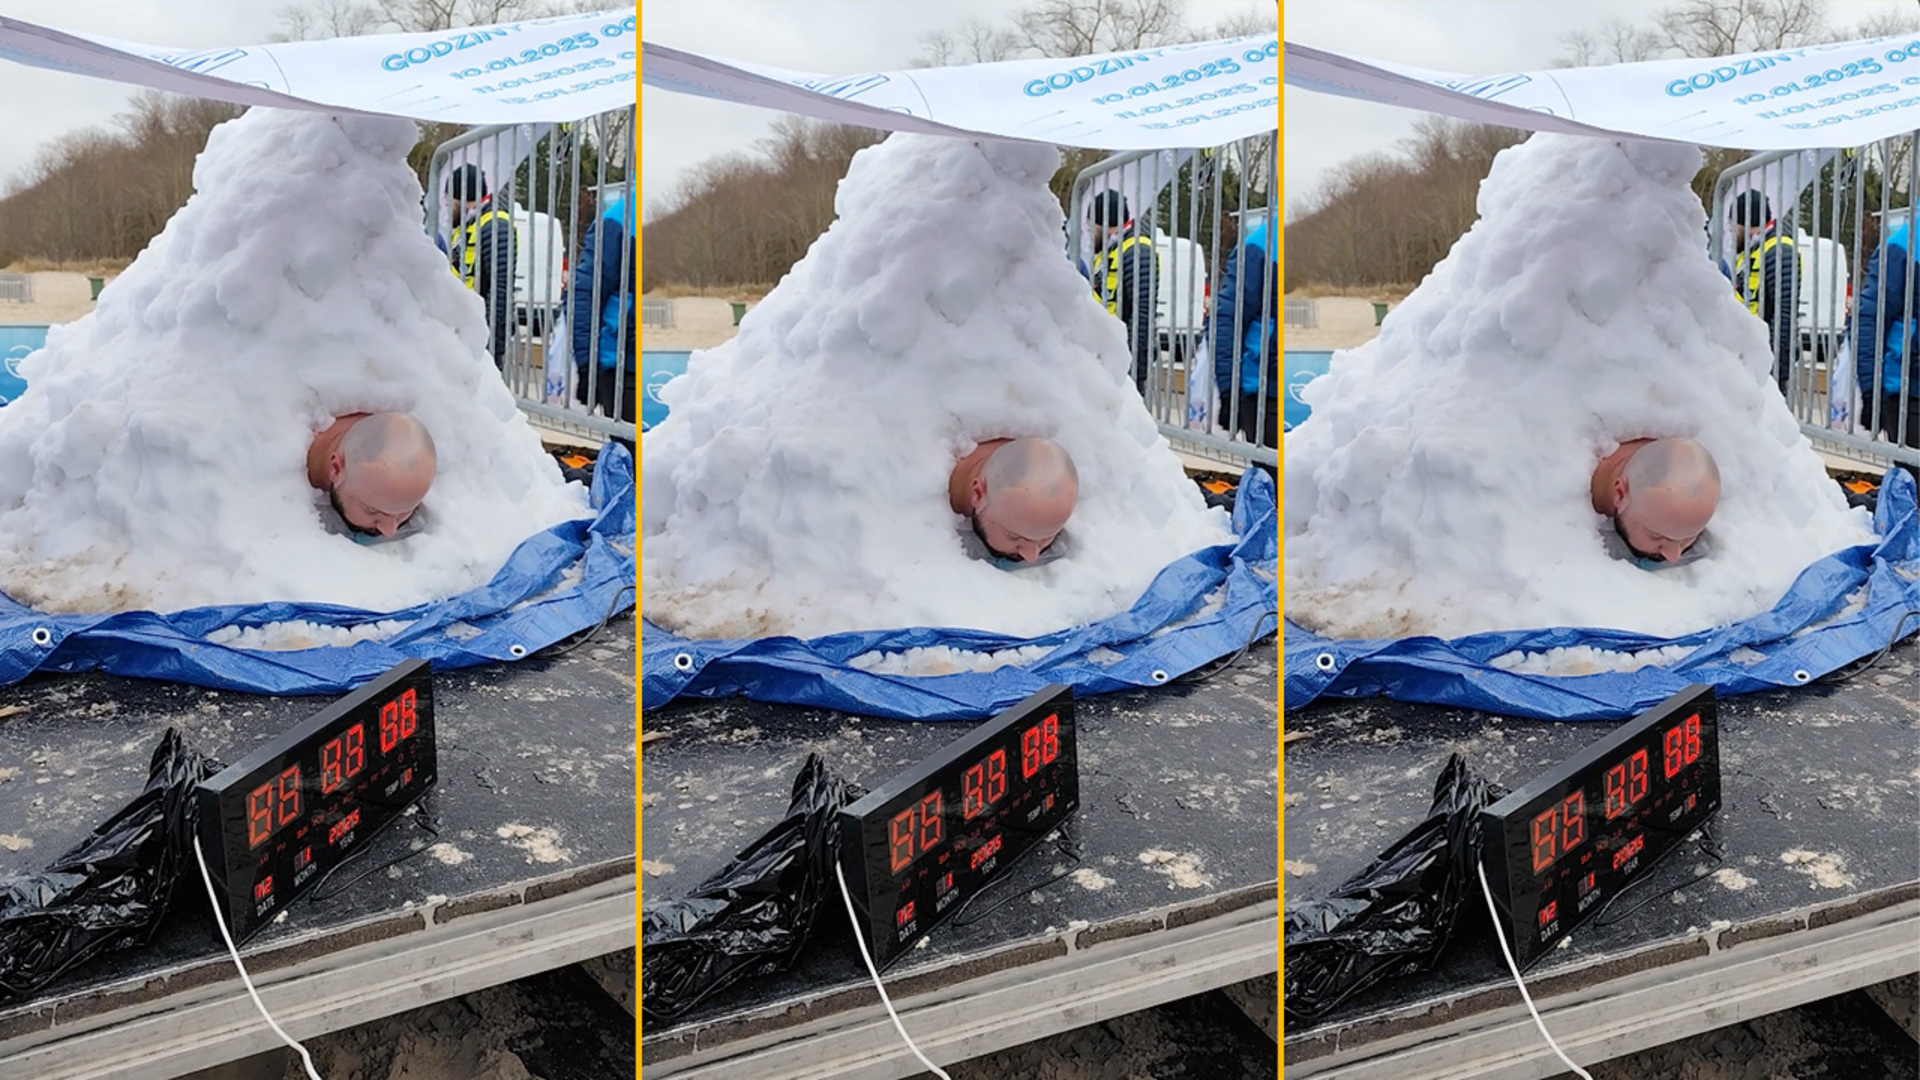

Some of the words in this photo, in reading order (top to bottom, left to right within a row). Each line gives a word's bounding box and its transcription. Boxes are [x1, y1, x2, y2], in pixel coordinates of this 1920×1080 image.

[381, 24, 521, 72] GODZINY
[450, 32, 599, 79] 10.01.2025
[473, 57, 615, 93] 11.01.2025
[1023, 49, 1163, 97] GODZINY
[1092, 57, 1241, 104] 10.01.2025
[1665, 49, 1805, 97] GODZINY
[1734, 57, 1883, 104] 10.01.2025
[1115, 82, 1257, 118] 11.01.2025
[1757, 82, 1899, 118] 11.01.2025
[328, 808, 360, 844] 2025
[339, 831, 355, 850] YEAR
[970, 833, 1002, 869] 2025
[981, 856, 997, 875] YEAR
[1612, 833, 1644, 869] 2025
[1623, 856, 1639, 875] YEAR
[294, 862, 317, 887] MONTH
[256, 896, 275, 917] DATE
[936, 887, 959, 912] MONTH
[1578, 887, 1601, 912] MONTH
[898, 921, 917, 942] DATE
[1540, 921, 1559, 942] DATE
